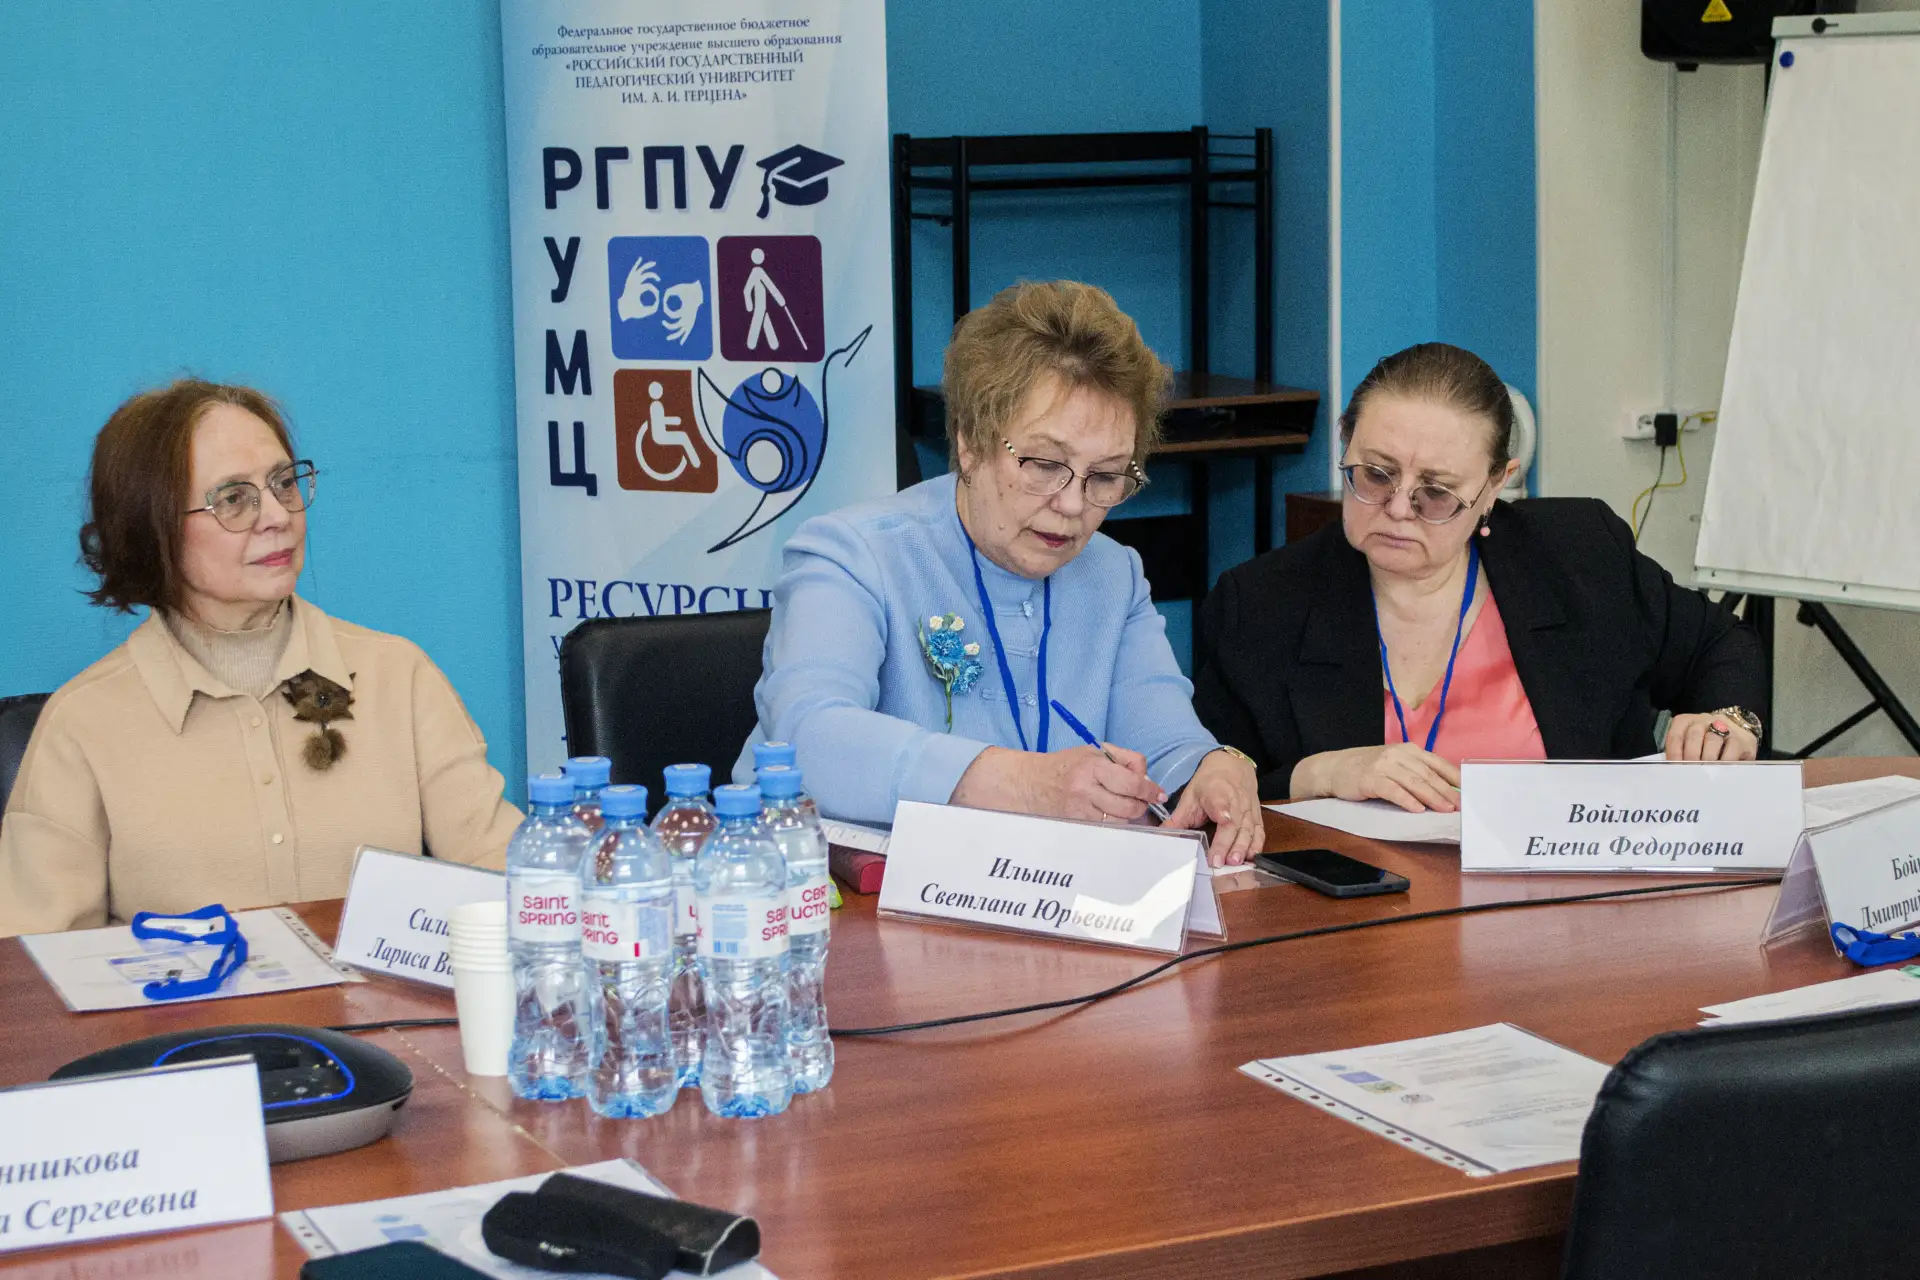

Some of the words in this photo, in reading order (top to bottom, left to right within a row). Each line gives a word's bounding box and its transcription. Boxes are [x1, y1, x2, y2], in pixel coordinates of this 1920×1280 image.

[557, 25, 634, 39] Федеральное
[637, 21, 737, 37] государственное
[740, 16, 811, 32] бюджетное
[532, 43, 627, 58] образовательное
[630, 38, 703, 54] учреждение
[707, 36, 760, 50] высшего
[763, 33, 843, 49] образования
[565, 53, 666, 71] «РОССИЙСКИЙ
[669, 49, 804, 69] ГОСУДАРСТВЕННЫЙ
[575, 72, 695, 89] ПЕДАГОГИЧЕСКИЙ
[698, 69, 796, 86] УНИВЕРСИТЕТ
[621, 91, 648, 104] ИМ.
[651, 91, 664, 103] А.
[667, 90, 680, 102] И.
[684, 88, 748, 105] ГЕРЦЕНА»
[542, 144, 745, 210] РГПУ
[1567, 802, 1701, 824] Войлокова
[1524, 835, 1600, 856] Елена
[1608, 835, 1745, 861] Федоровна
[987, 857, 1075, 888] Ильина
[920, 882, 1028, 918] Светлана
[1031, 898, 1135, 934] Юрьевна
[367, 937, 431, 970] Лариса
[0, 1148, 140, 1184] нникова
[25, 1187, 198, 1235] Сергеевна
